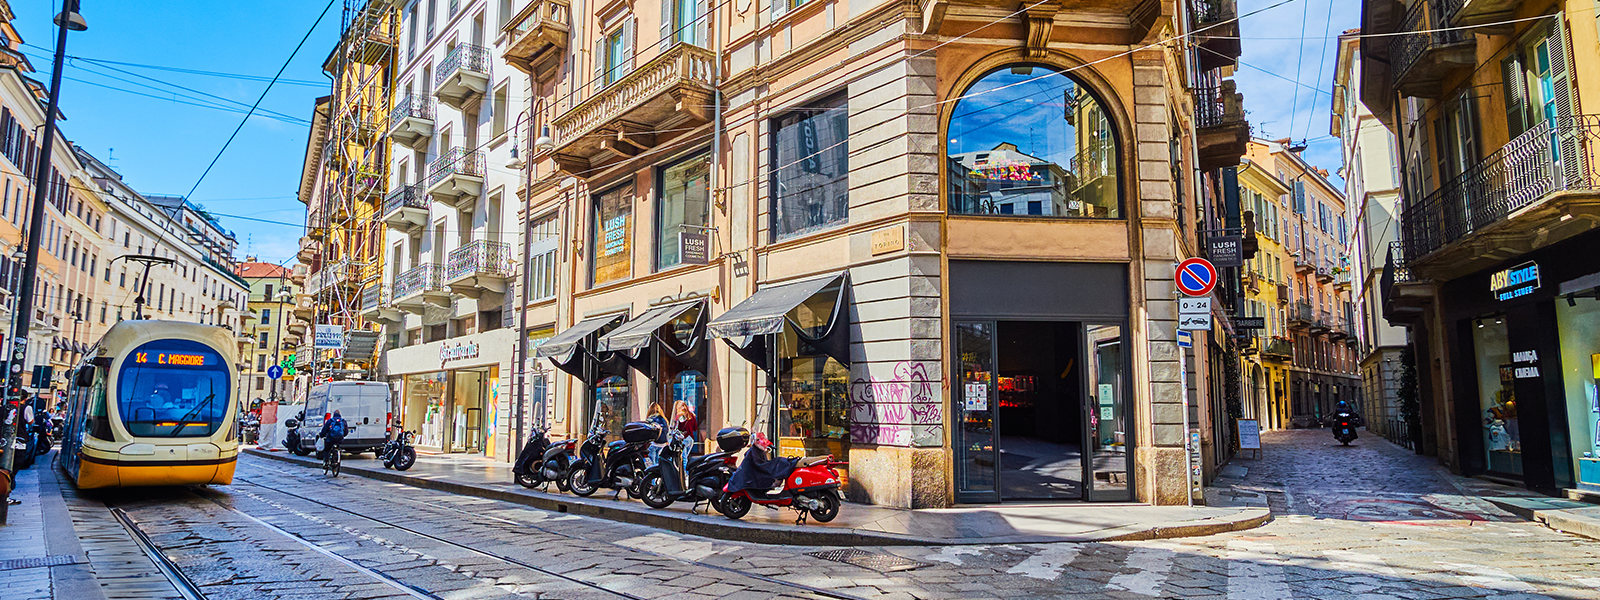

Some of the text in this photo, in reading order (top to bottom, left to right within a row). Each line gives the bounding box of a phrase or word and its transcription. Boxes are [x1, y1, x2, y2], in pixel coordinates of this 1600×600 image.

[605, 215, 625, 232] LUSH
[605, 227, 625, 242] FRESH
[685, 238, 704, 246] LUSH
[1213, 241, 1236, 249] LUSH
[1510, 265, 1537, 286] STYLE
[1500, 285, 1533, 301] FULL STUFF
[136, 352, 204, 366] 14 C. MAGGIORE
[1513, 350, 1538, 364] MANGA
[1515, 366, 1540, 379] CINEMA
